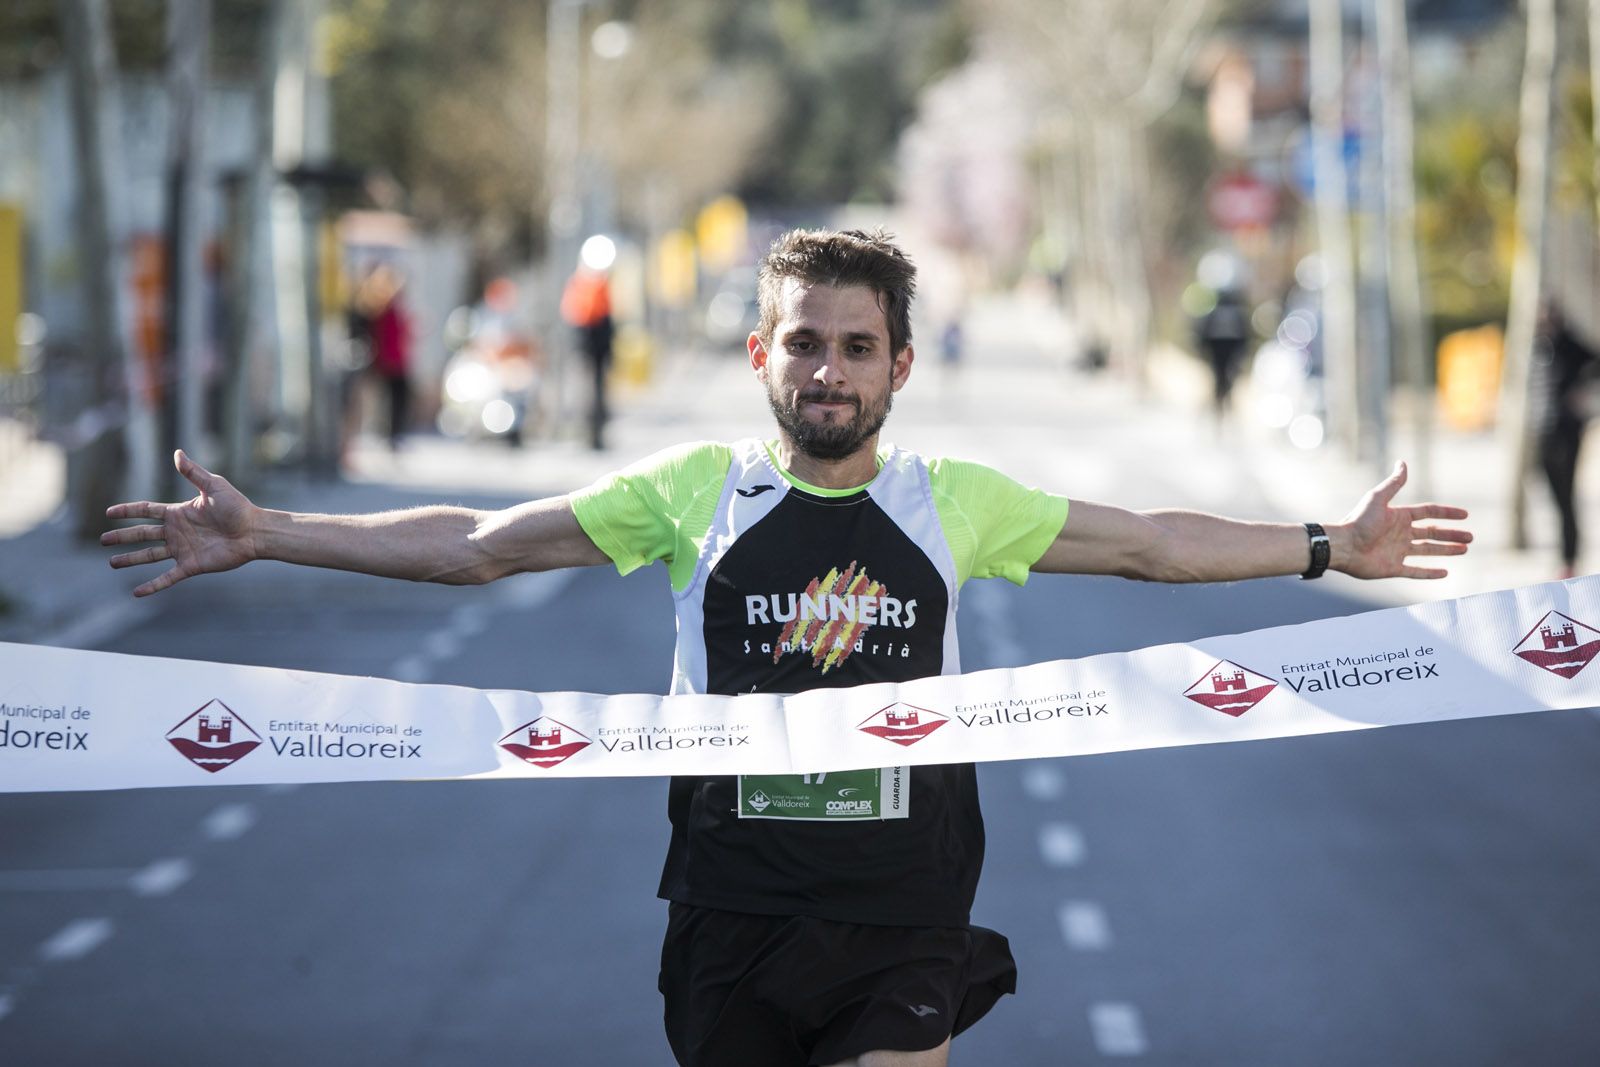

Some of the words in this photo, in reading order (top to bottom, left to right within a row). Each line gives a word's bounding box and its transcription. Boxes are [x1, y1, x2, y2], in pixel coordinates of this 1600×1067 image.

[745, 592, 918, 629] RUNNERS
[744, 639, 811, 654] Sant
[833, 636, 910, 658] Adrià
[1281, 660, 1331, 674] Entitat
[1336, 648, 1410, 667] Municipal
[1414, 646, 1434, 657] de
[1284, 661, 1439, 693] Valldoreix
[70, 705, 91, 720] de
[955, 700, 1004, 713] Entitat
[1009, 691, 1082, 706] Municipal
[1087, 690, 1106, 699] de
[957, 702, 1109, 728] Valldoreix
[268, 720, 319, 732] Entitat
[324, 722, 397, 736] Municipal
[403, 725, 422, 737] de
[598, 726, 648, 736] Entitat
[653, 723, 725, 735] Municipal
[730, 724, 750, 732] de
[269, 734, 421, 759] Valldoreix
[600, 734, 750, 753] Valldoreix
[772, 799, 810, 808] Valldoreix
[826, 800, 873, 810] COMPLEX
